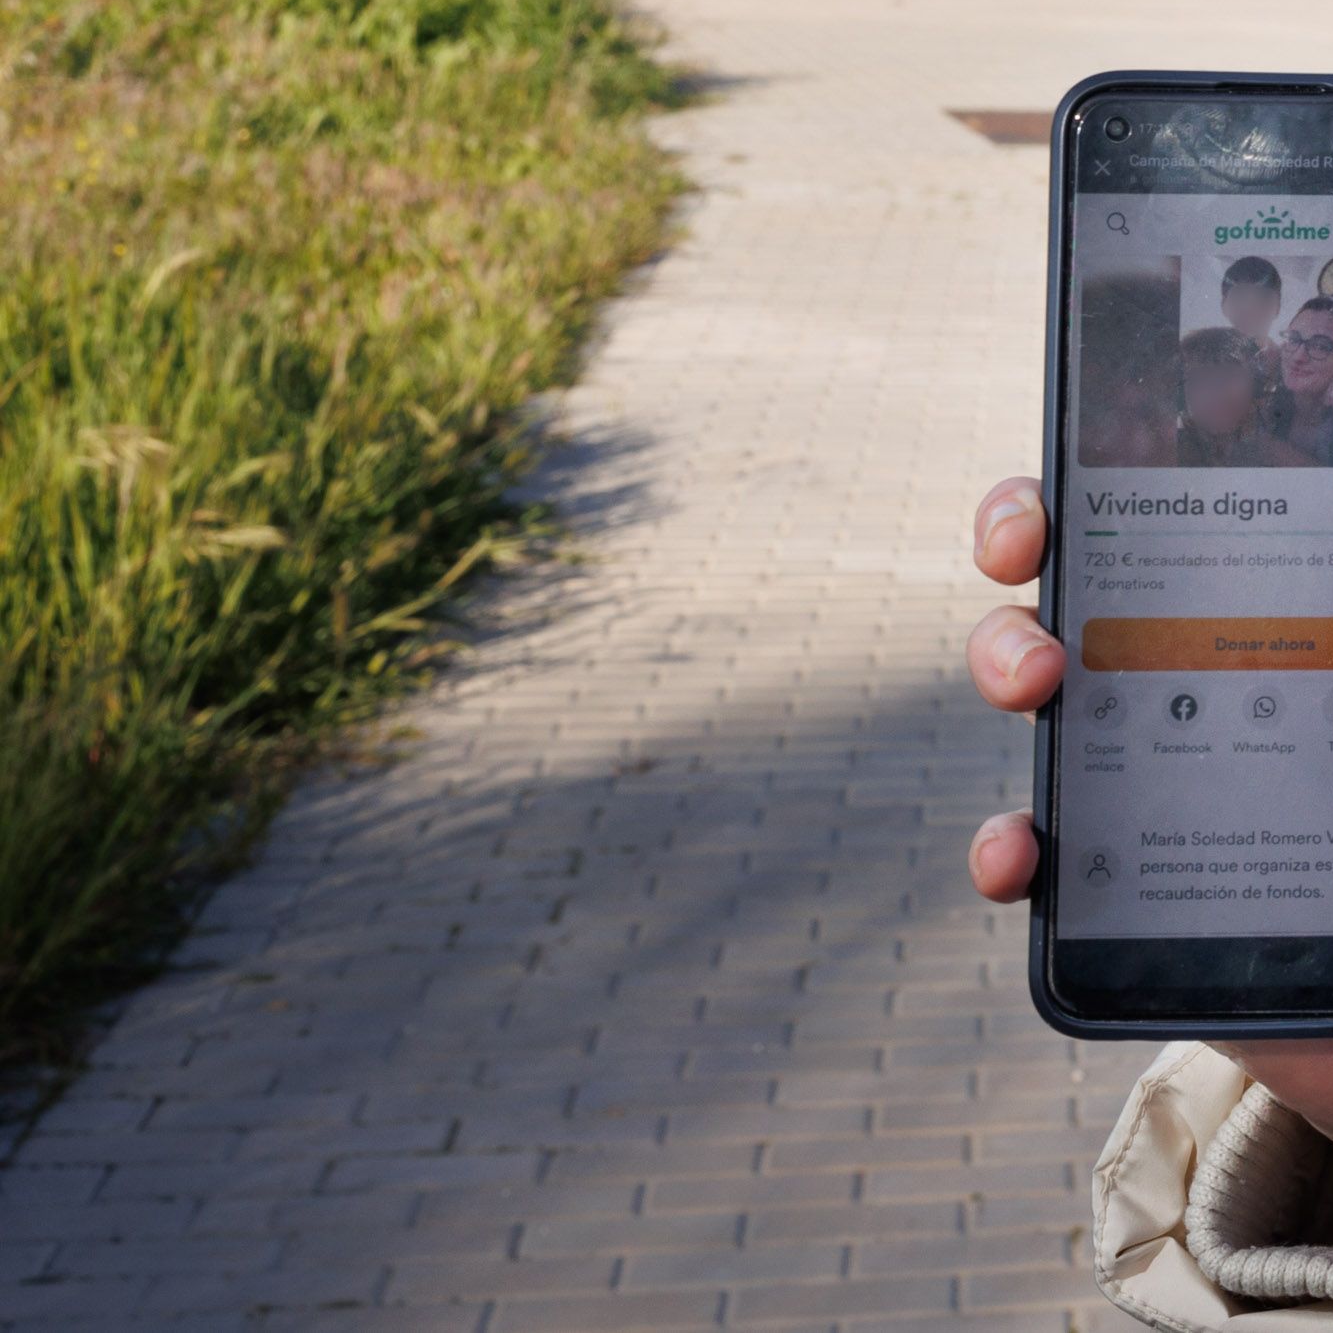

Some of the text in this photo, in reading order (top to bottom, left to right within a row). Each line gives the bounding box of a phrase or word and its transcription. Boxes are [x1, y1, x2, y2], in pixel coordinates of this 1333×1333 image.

[1199, 153, 1216, 167] de
[1263, 154, 1320, 169] Soledad
[1214, 218, 1331, 245] gofundme
[1085, 491, 1289, 522] Vivienda digna
[1084, 551, 1117, 567] 720
[1121, 551, 1134, 567] €
[1137, 552, 1219, 567] recaudados
[1222, 553, 1243, 567] del
[1247, 553, 1303, 569] objetivo
[1306, 553, 1325, 567] de
[1083, 575, 1166, 591] 7 donativos
[1214, 637, 1317, 651] Donar ahora
[1084, 742, 1125, 755] Copiar
[1153, 741, 1213, 754] Facebook
[1232, 741, 1296, 755] WhatsApp
[1084, 760, 1126, 772] enlace
[1140, 831, 1186, 847] María
[1190, 830, 1256, 847] Soledad
[1260, 829, 1323, 846] Romero
[1139, 862, 1205, 877] persona
[1207, 861, 1239, 876] que
[1243, 858, 1311, 876] organiza
[1139, 884, 1326, 901] recaudación de fondos.
